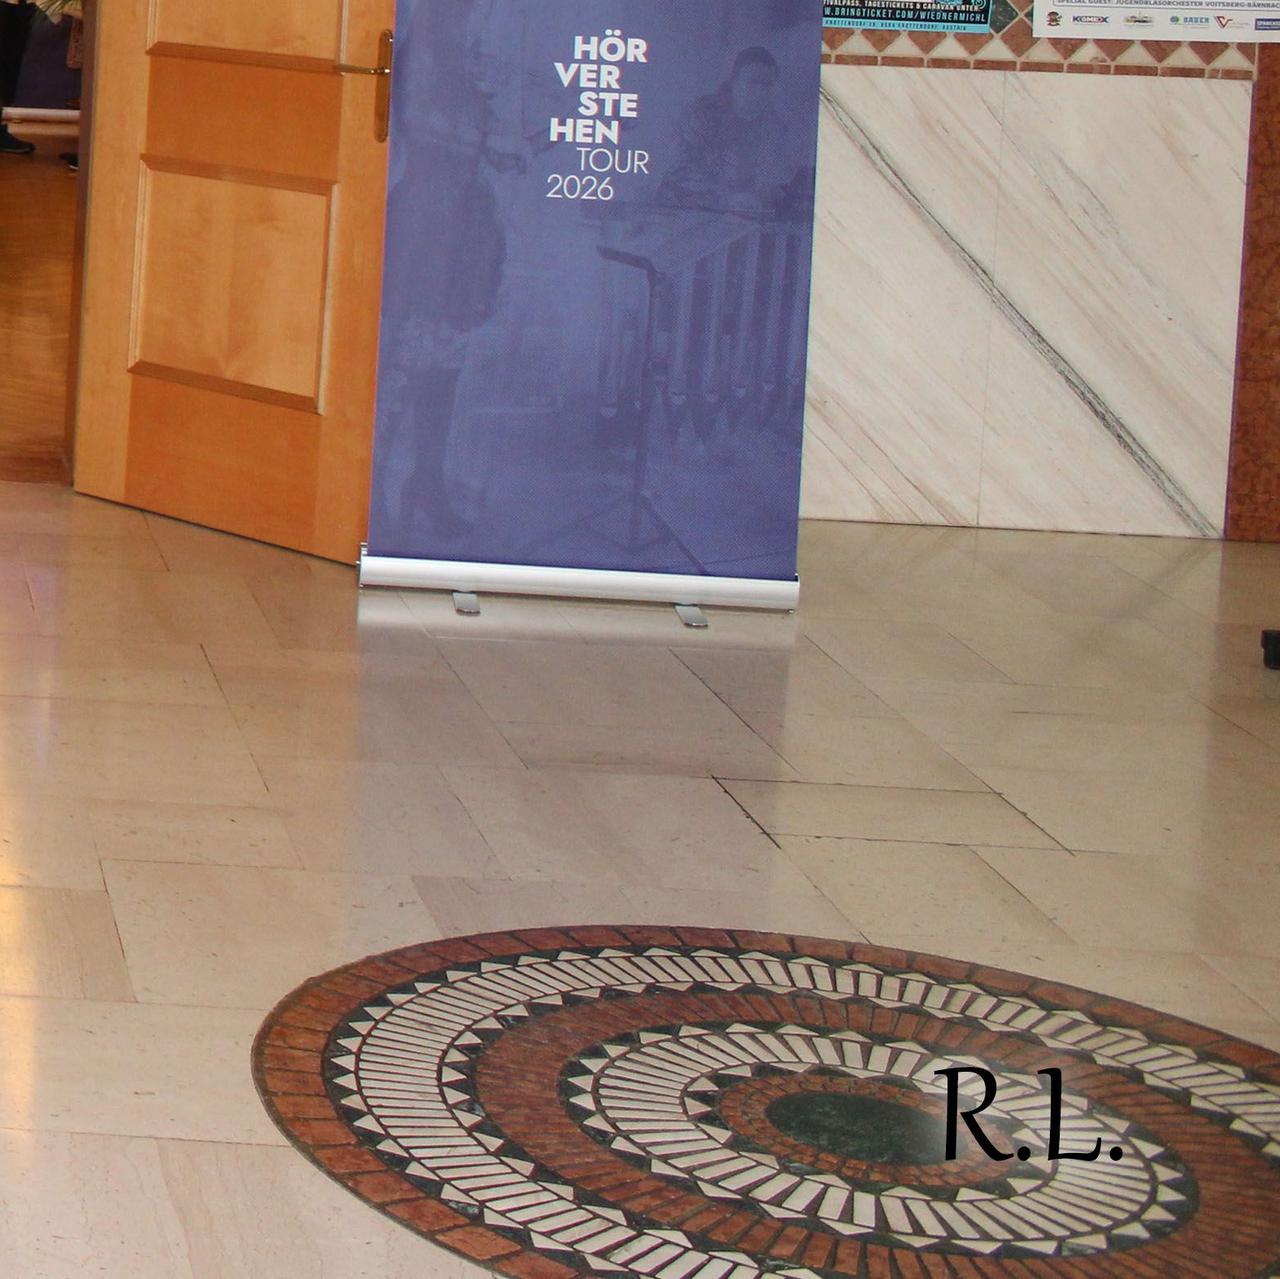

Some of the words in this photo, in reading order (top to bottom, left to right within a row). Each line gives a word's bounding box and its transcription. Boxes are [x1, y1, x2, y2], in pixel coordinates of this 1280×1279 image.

[865, 1, 916, 9] TAGESTICKETS
[922, 3, 954, 11] CARAVAN
[573, 29, 648, 63] HÖR
[553, 62, 621, 89] VER
[577, 91, 639, 118] STE
[549, 117, 620, 145] HEN
[576, 147, 649, 174] TOUR
[546, 174, 614, 201] 2026
